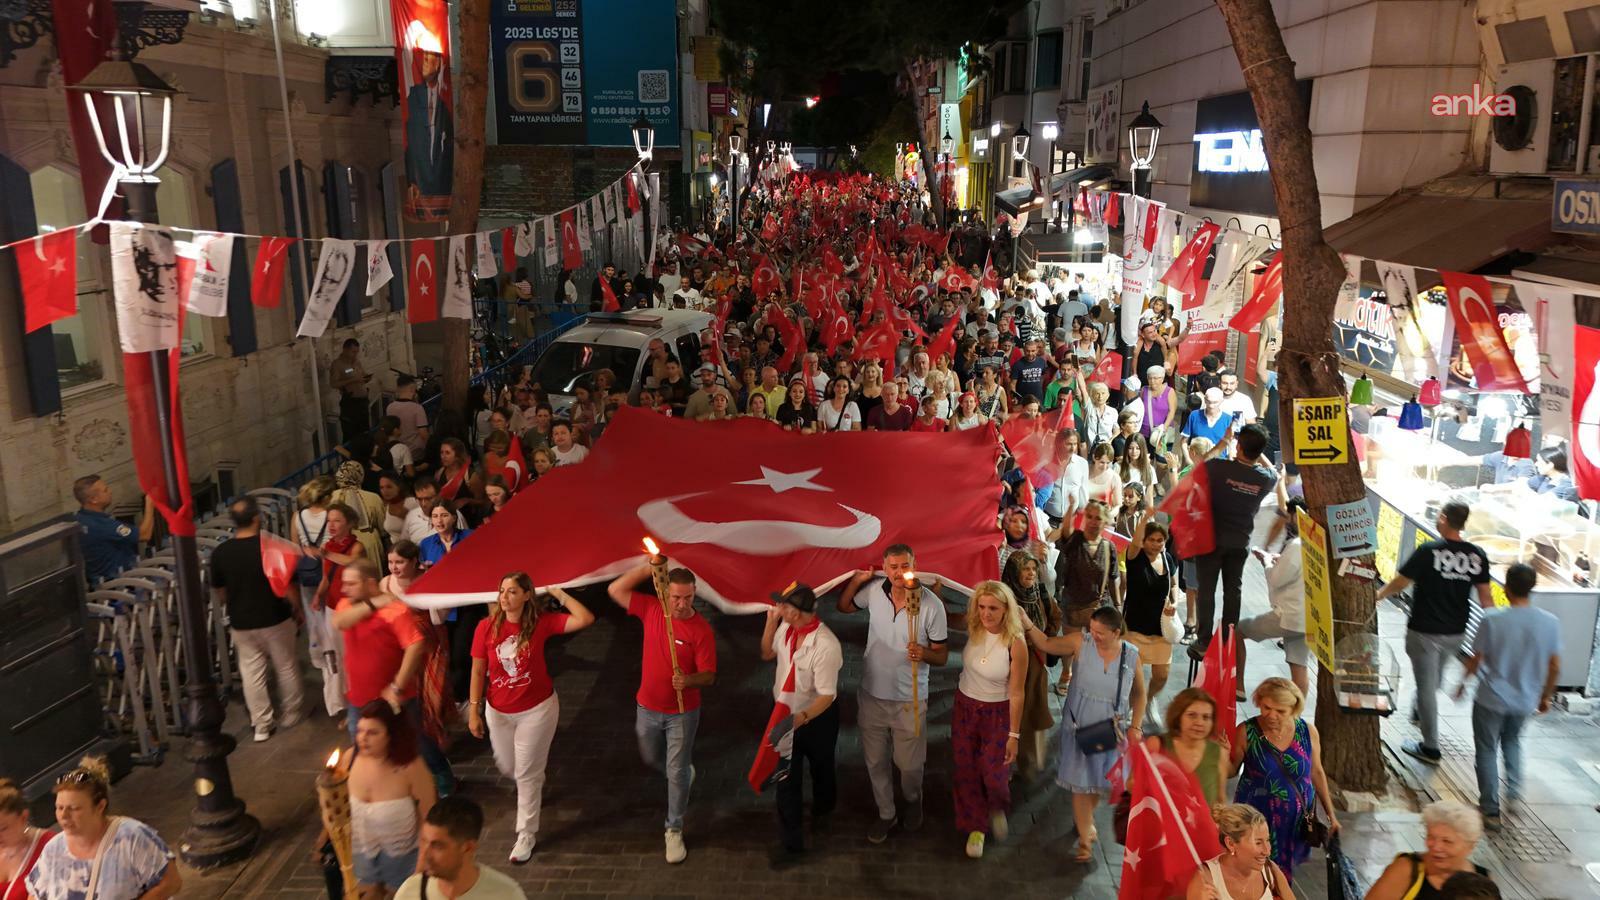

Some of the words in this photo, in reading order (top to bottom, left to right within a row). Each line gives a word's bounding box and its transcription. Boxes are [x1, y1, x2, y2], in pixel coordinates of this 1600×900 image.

[505, 27, 533, 39] 2025
[535, 27, 579, 39] LGS'DE
[563, 46, 577, 57] 32
[506, 42, 559, 112] 6
[565, 71, 578, 81] 46
[565, 96, 579, 105] 78
[551, 113, 583, 122] ÖĞRENCİ
[1191, 320, 1225, 333] BEDAVA
[1298, 405, 1342, 424] EŞARP
[1307, 425, 1333, 444] ŞAL
[1335, 507, 1367, 520] GÖZLÜK
[1432, 548, 1483, 575] 1903
